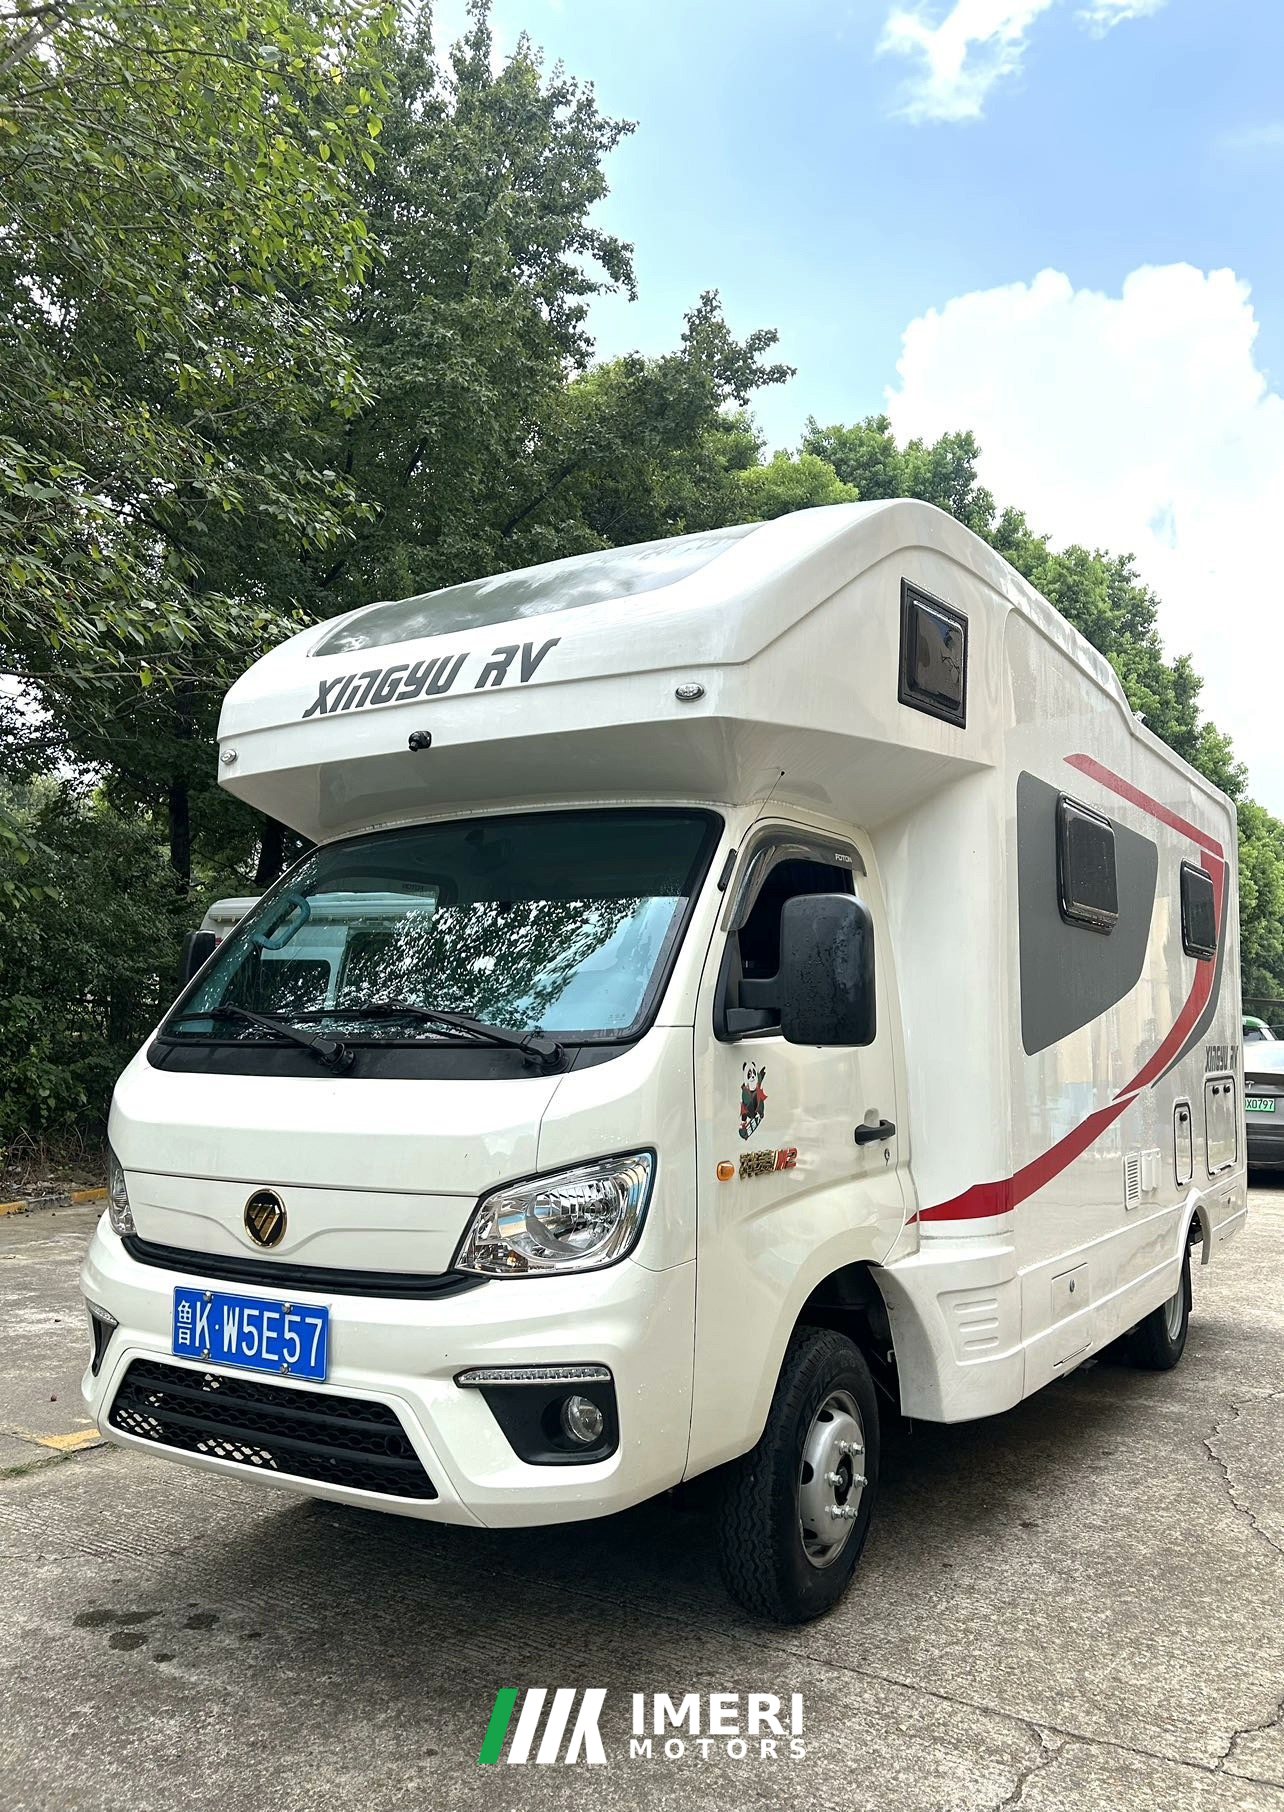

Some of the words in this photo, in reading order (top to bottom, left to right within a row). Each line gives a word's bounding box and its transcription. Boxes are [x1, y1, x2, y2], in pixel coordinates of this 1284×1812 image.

[302, 652, 471, 719] XINGYU
[474, 637, 562, 689] RV
[835, 853, 853, 863] FOTON
[1245, 1099, 1274, 1110] X0797
